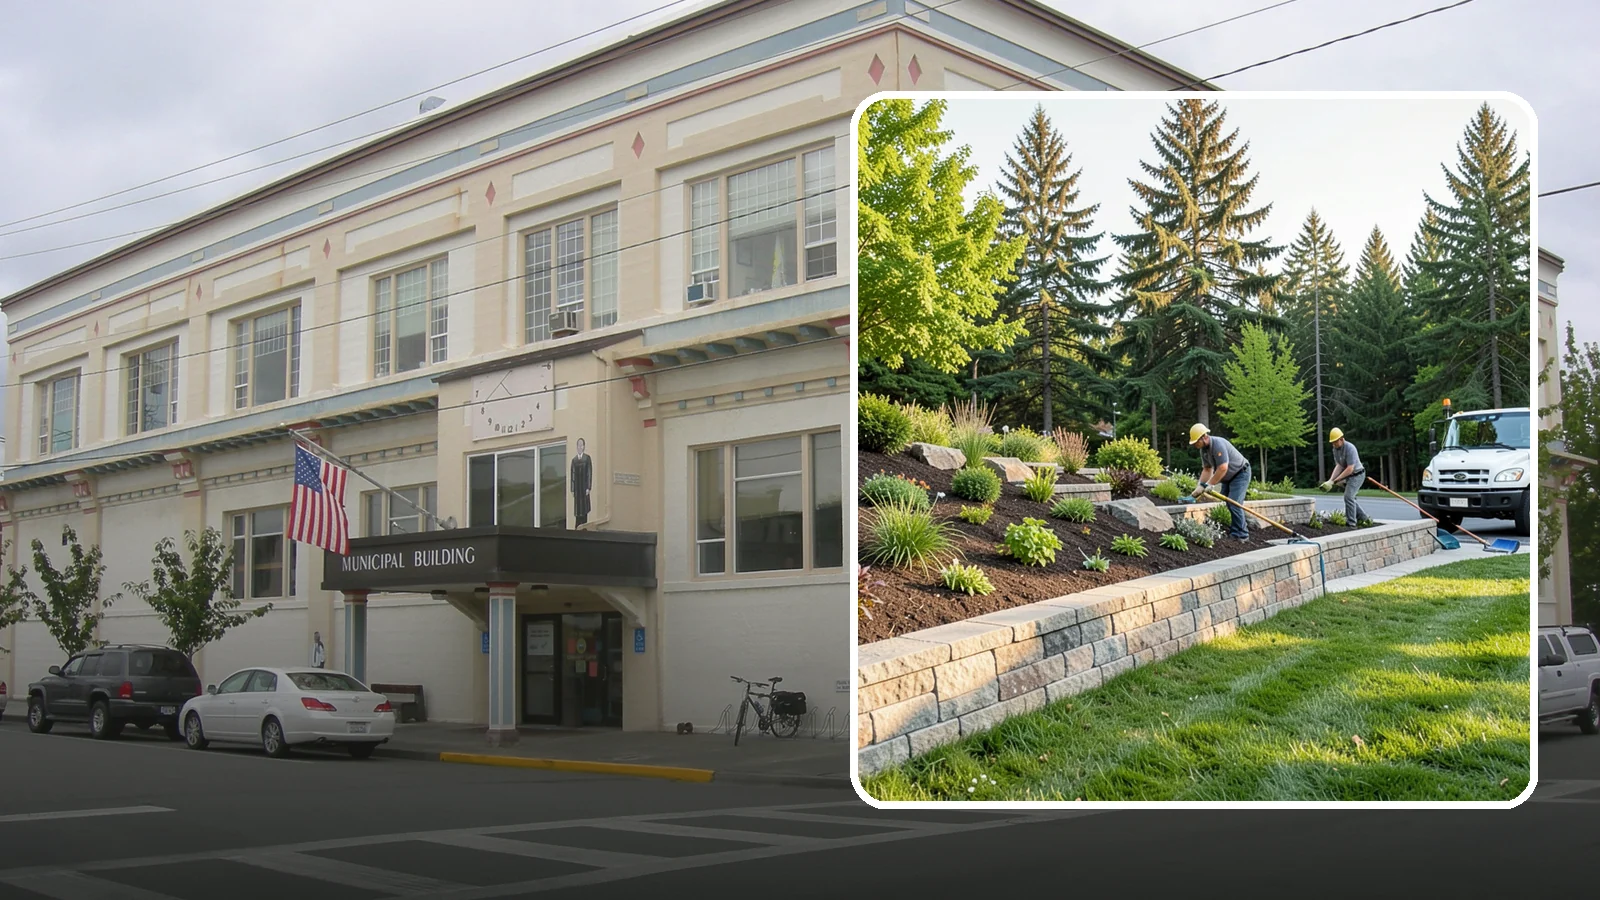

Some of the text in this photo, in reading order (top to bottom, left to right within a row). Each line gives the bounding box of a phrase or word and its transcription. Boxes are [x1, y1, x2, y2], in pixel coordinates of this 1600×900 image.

[475, 390, 479, 398] 7
[480, 407, 485, 415] 8
[488, 417, 492, 426] 9
[494, 423, 500, 432] 10
[507, 425, 513, 433] 12
[521, 420, 525, 428] 2
[529, 414, 533, 422] 3
[536, 402, 540, 410] 4
[342, 546, 475, 571] MUNICIPAL BUILDING
